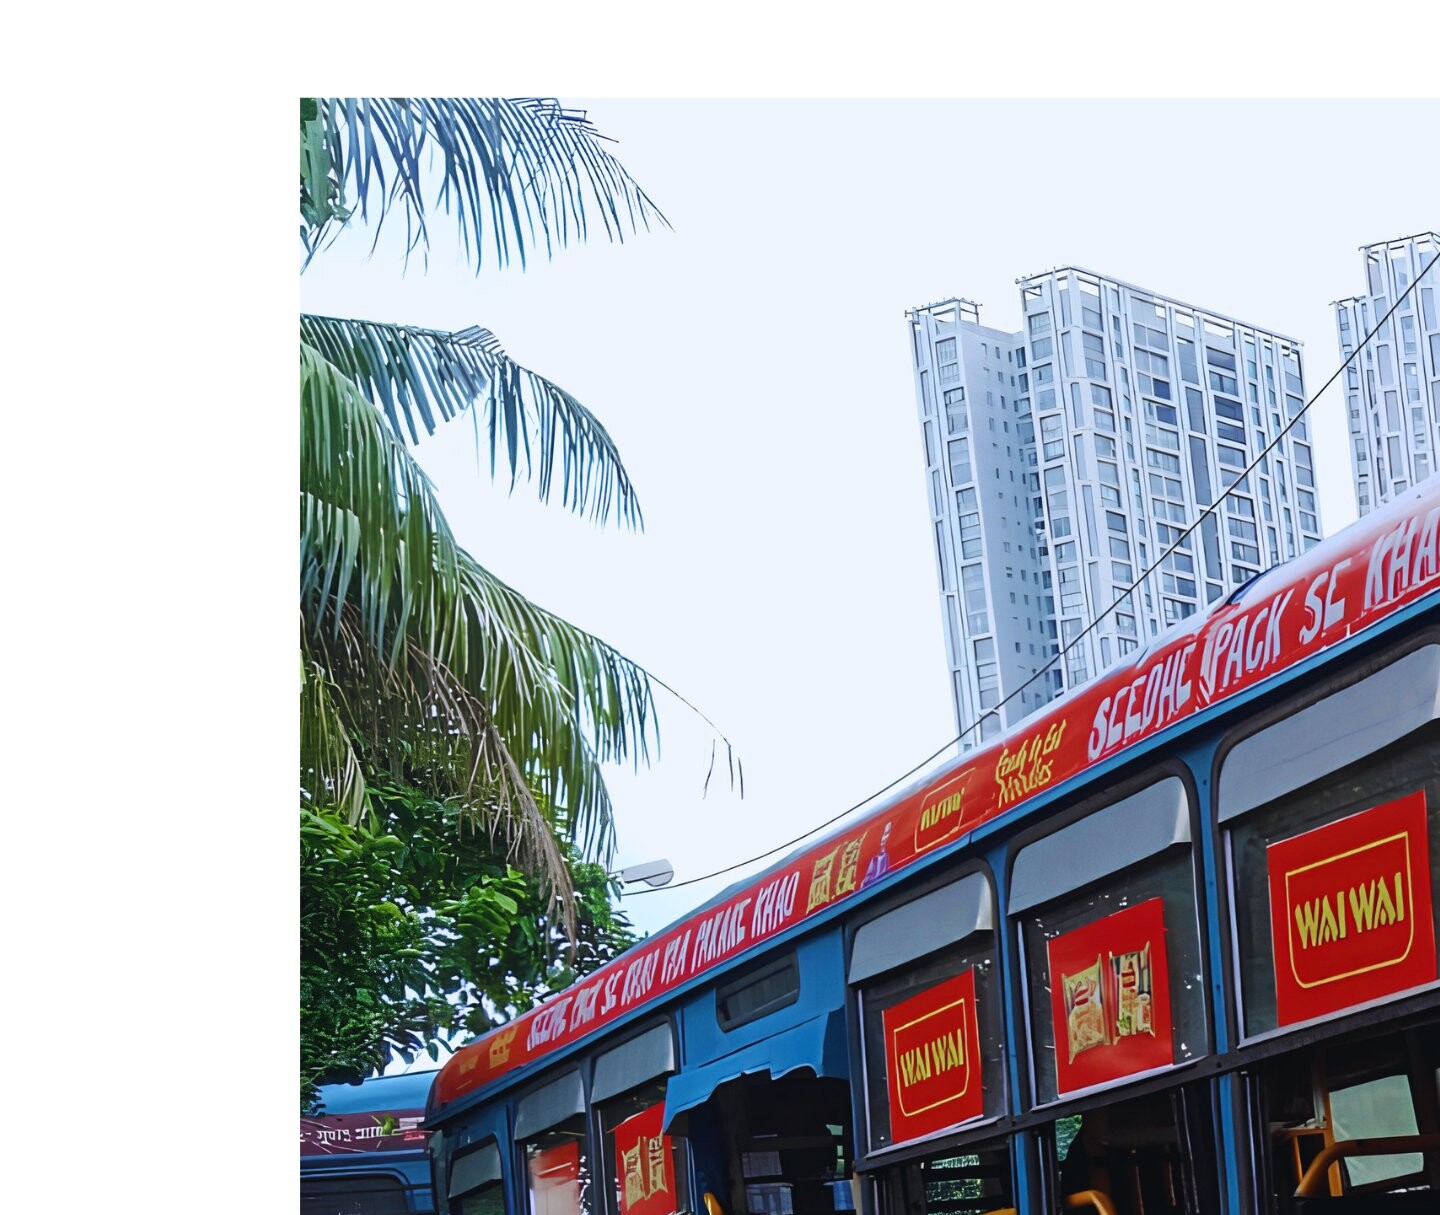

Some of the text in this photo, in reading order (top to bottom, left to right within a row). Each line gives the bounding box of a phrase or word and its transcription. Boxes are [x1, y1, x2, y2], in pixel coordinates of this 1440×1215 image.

[1087, 640, 1198, 760] SEEDHE
[1299, 557, 1352, 645] SE
[1295, 871, 1404, 950] WAI WAI
[900, 1028, 964, 1088] WAI WAI
